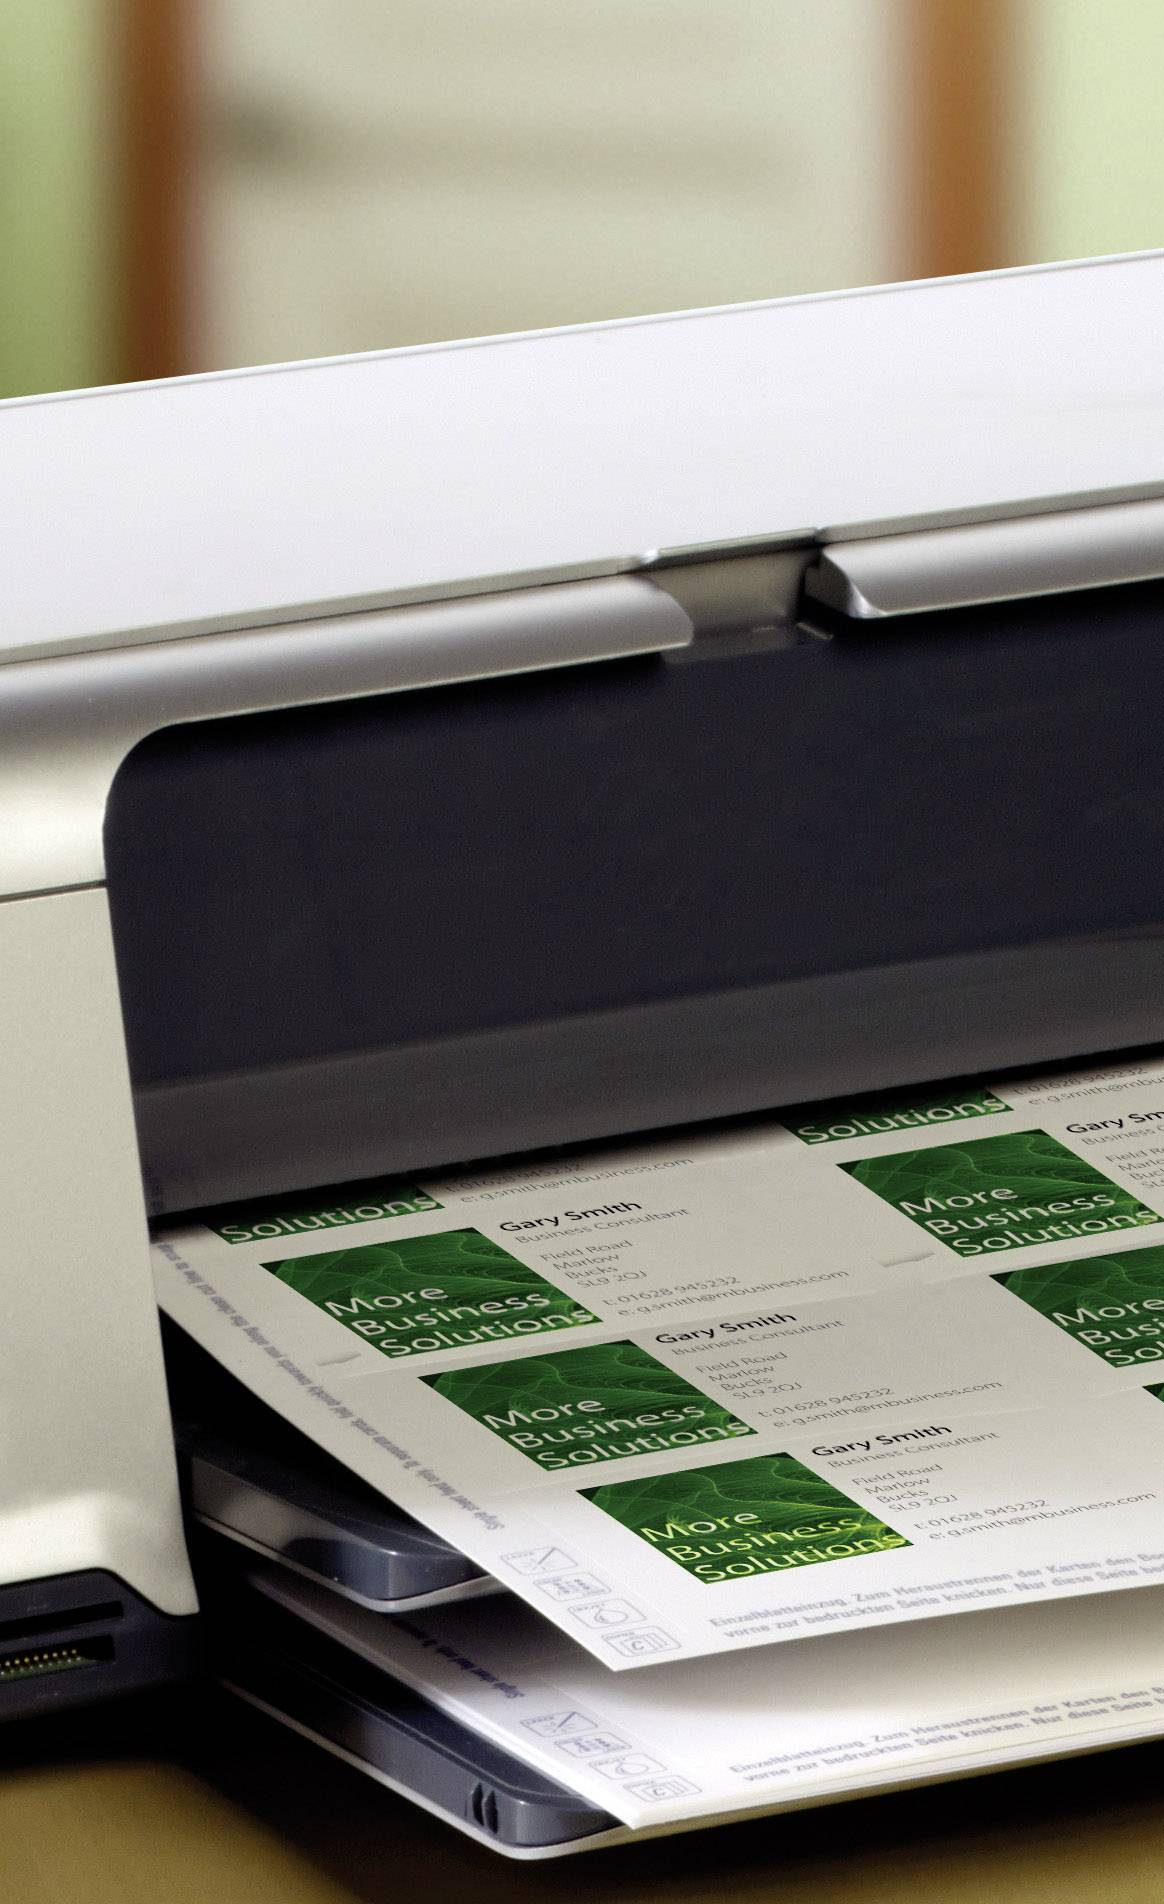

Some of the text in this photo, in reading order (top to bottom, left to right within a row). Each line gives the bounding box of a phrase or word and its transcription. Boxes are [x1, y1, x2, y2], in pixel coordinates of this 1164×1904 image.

[797, 1098, 1006, 1142] Solutions
[1066, 1119, 1123, 1133] Gary
[1080, 1128, 1157, 1145] Business
[1105, 1150, 1148, 1162] Field
[900, 1189, 1017, 1215] More
[925, 1195, 1115, 1234] Business
[226, 1196, 438, 1242] Solutions
[500, 1202, 642, 1231] Gary Smith
[513, 1209, 688, 1243] Business Consultant
[953, 1211, 1158, 1253] Solutions
[540, 1240, 632, 1261] Field Road
[552, 1254, 619, 1272] Marlow
[564, 1267, 618, 1279] Bucks
[325, 1289, 448, 1316] More
[351, 1294, 550, 1335] Business
[380, 1310, 600, 1355] Solutions
[656, 1314, 796, 1343] Gary Smith
[671, 1321, 846, 1356] Business Consultant
[695, 1352, 788, 1373] Field Road
[708, 1366, 774, 1382] Marlow
[720, 1377, 773, 1391] Bucks
[483, 1401, 605, 1429] More
[509, 1407, 705, 1448] Business
[538, 1423, 749, 1467] Solutions
[812, 1426, 952, 1456] Gary Smith
[827, 1433, 999, 1468] Business Consultant
[852, 1464, 943, 1486] Field Road
[864, 1478, 929, 1494] Marlow
[876, 1490, 928, 1503] Bucks
[641, 1514, 761, 1541] More
[667, 1519, 862, 1561] Business
[695, 1534, 914, 1580] Solutions
